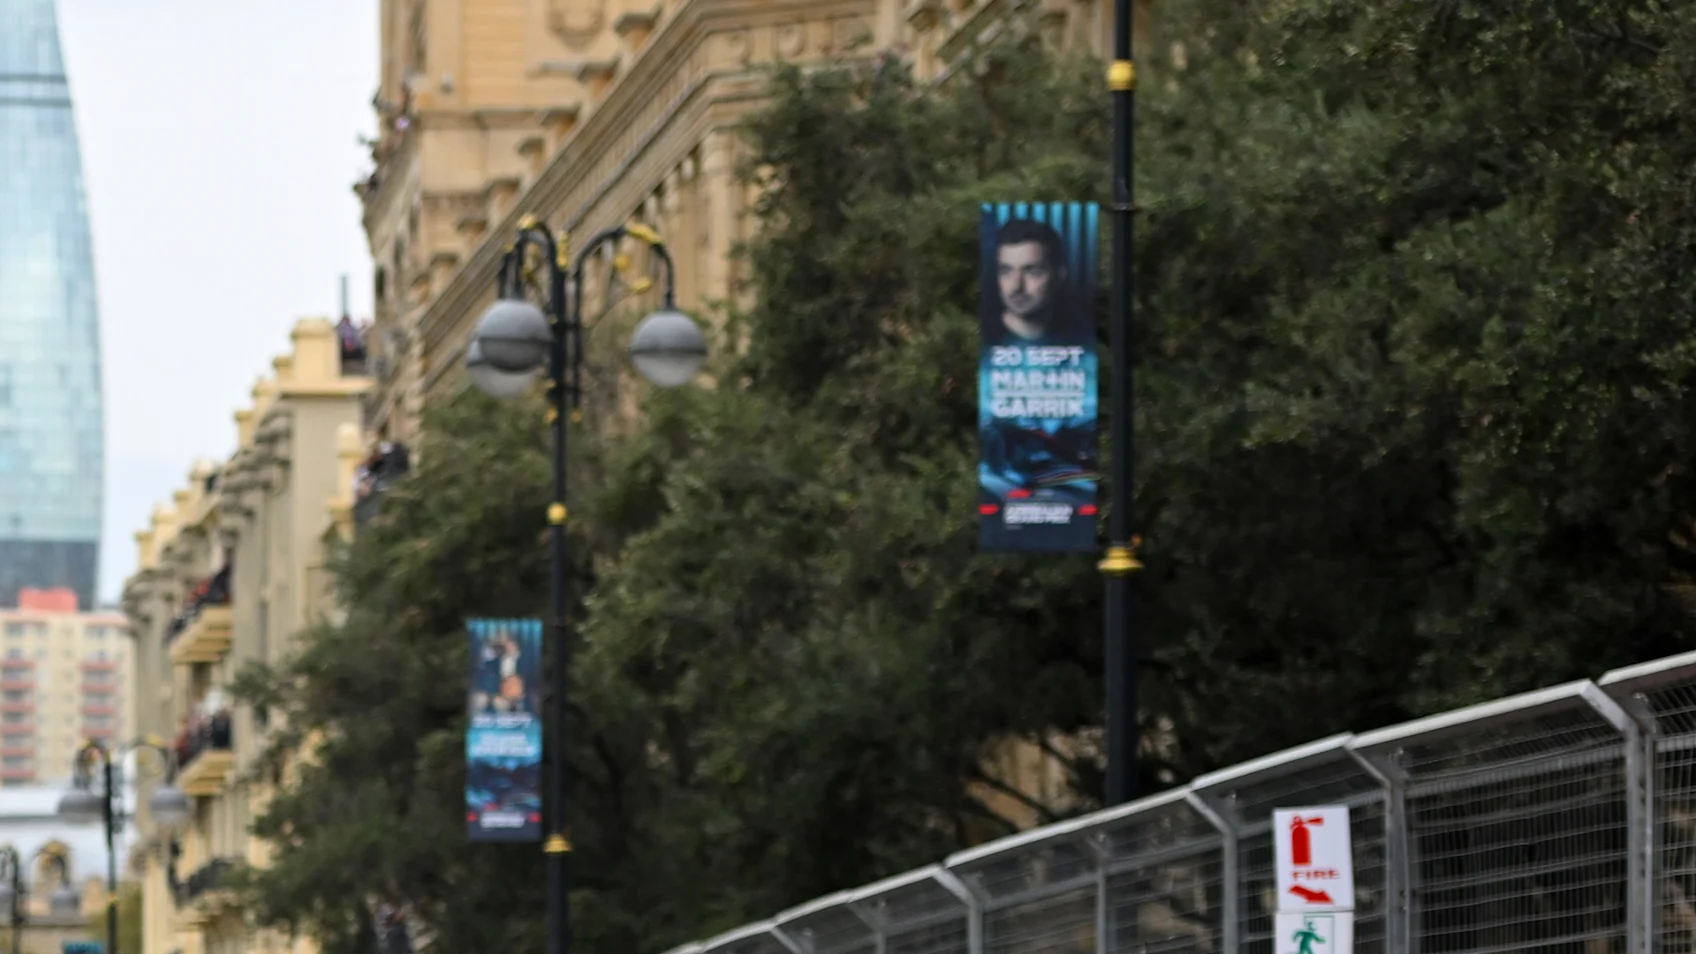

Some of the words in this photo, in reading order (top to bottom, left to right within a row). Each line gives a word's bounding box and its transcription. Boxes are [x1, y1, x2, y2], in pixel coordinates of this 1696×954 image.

[991, 345, 1022, 366] 20
[1026, 345, 1084, 366] SEPT
[1292, 869, 1340, 880] FIRE
